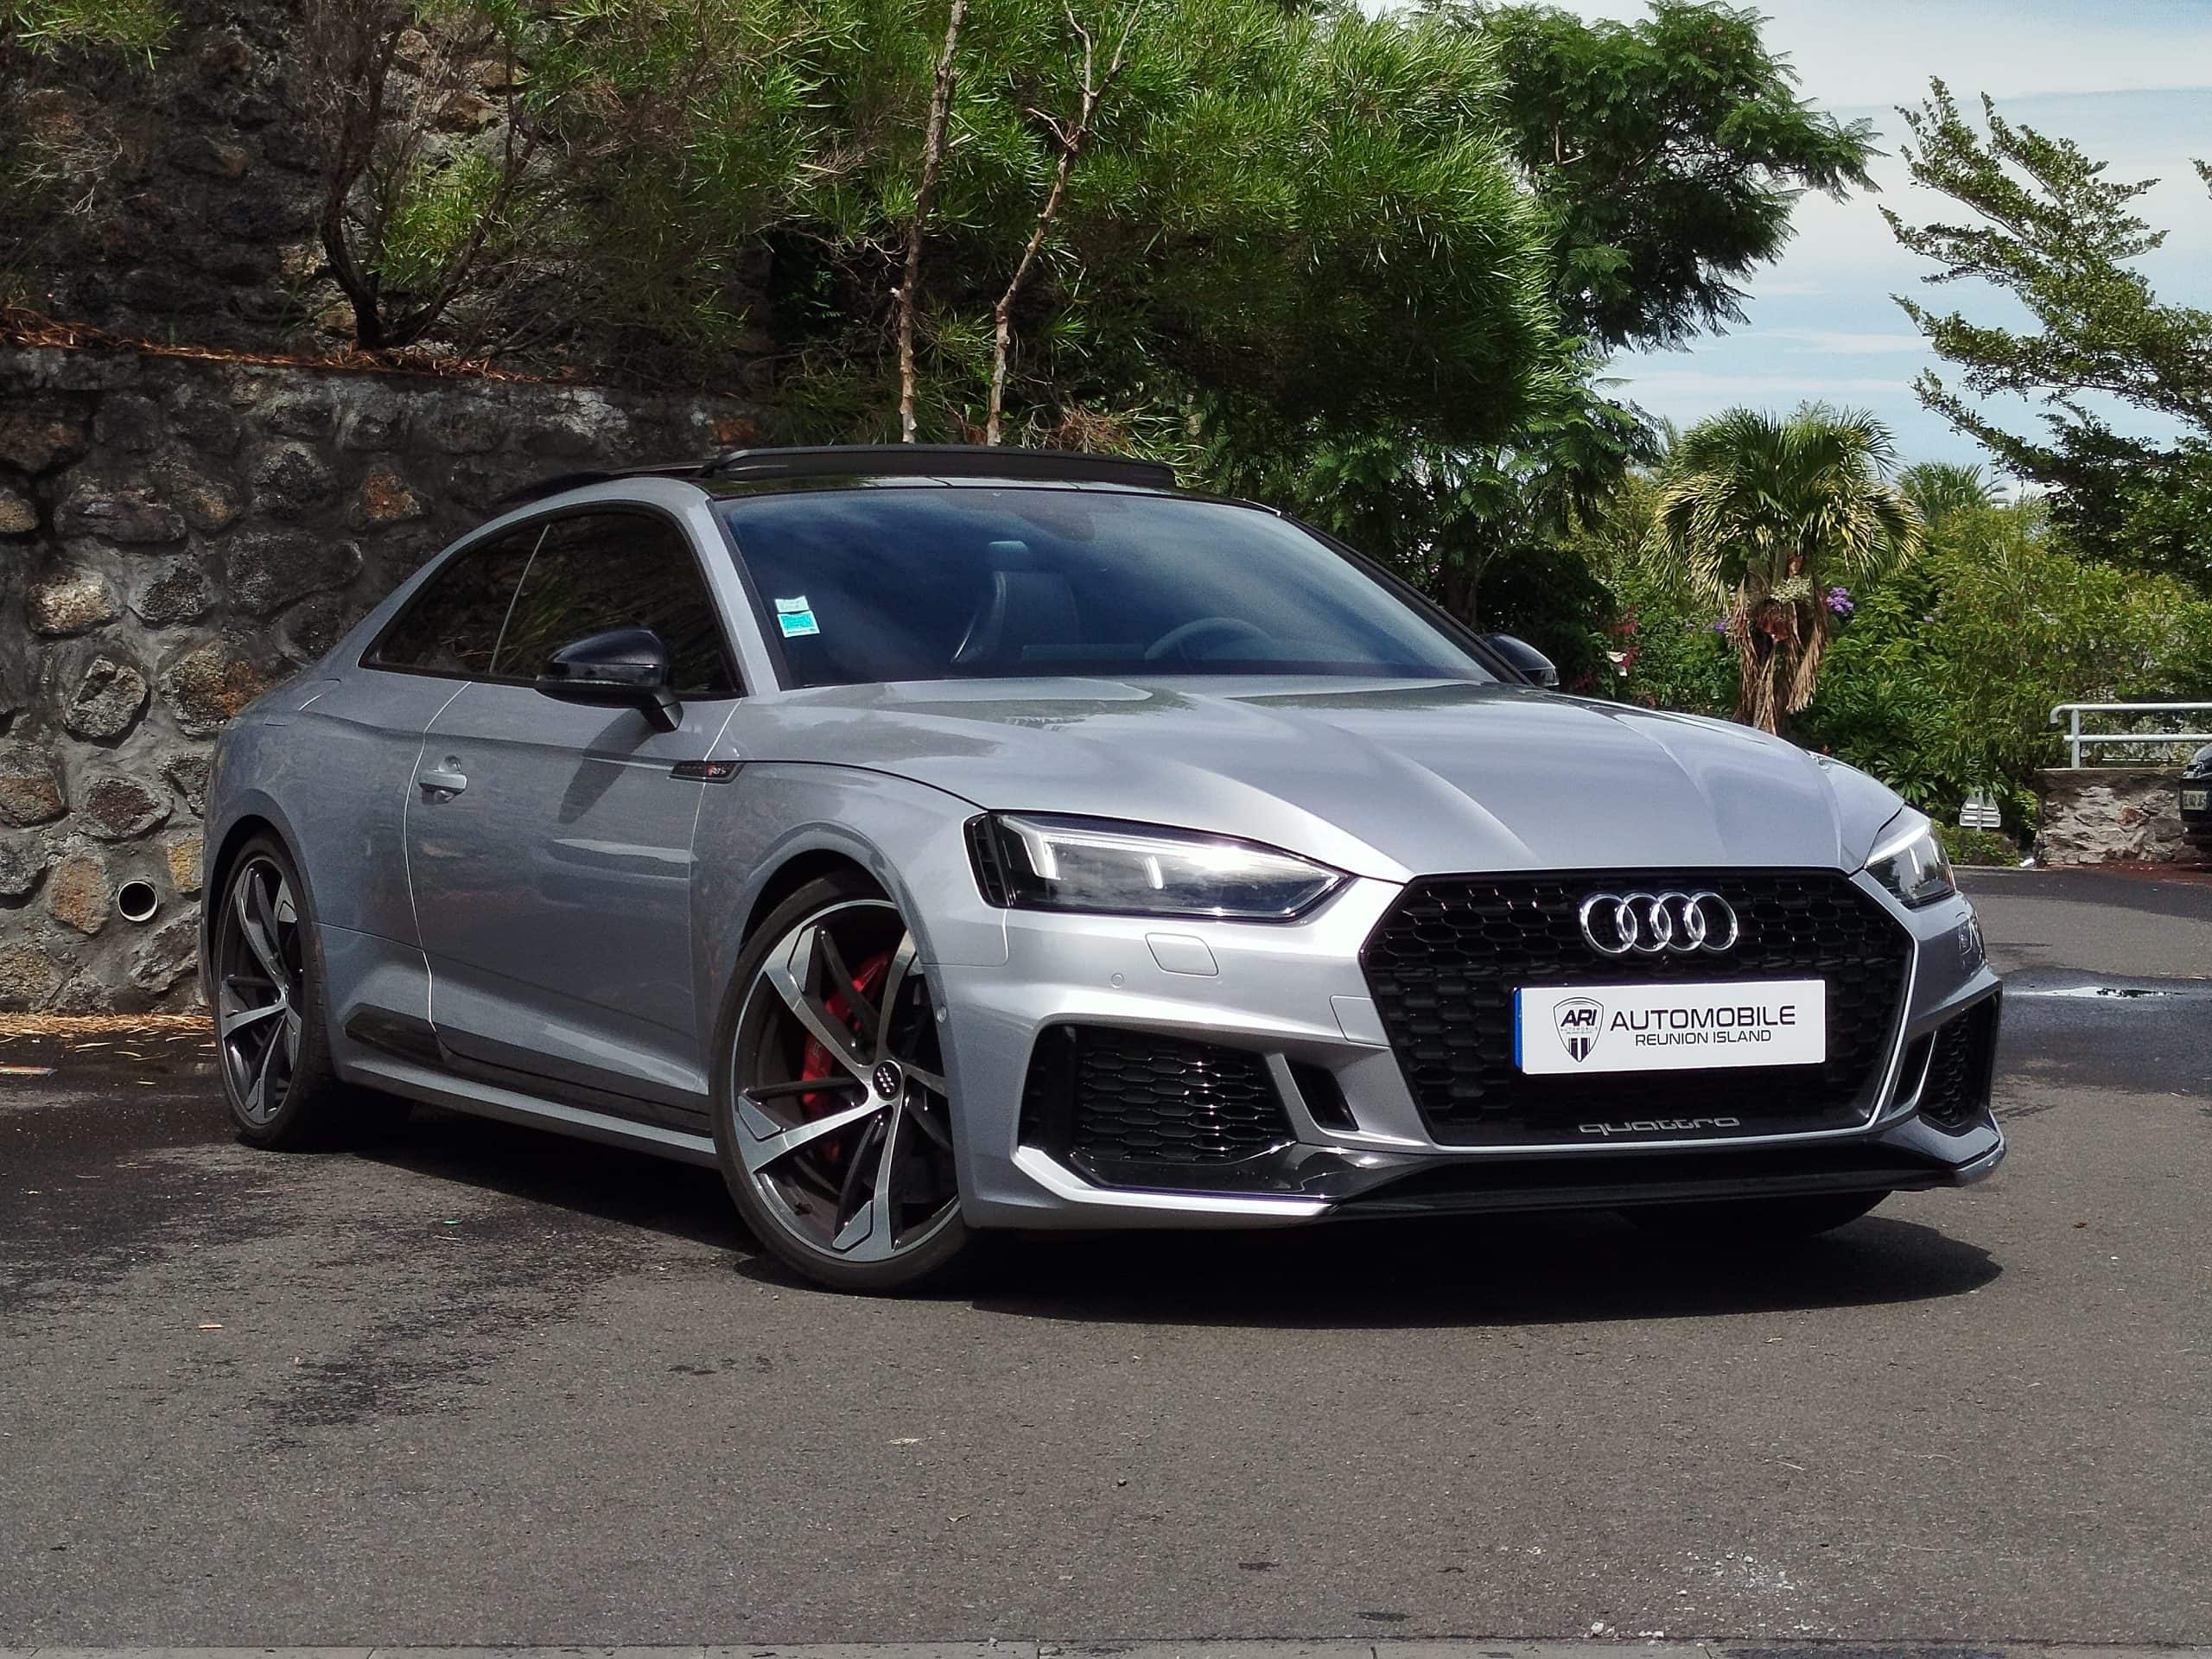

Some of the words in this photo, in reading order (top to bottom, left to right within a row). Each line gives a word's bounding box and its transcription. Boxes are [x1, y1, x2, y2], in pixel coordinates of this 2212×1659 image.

[1560, 1008, 1598, 1027] ARI
[1610, 1005, 1796, 1032] AUTOMOBILE
[1636, 1032, 1707, 1046] REUNION
[1713, 1029, 1771, 1044] ISLAND
[1579, 1117, 1740, 1136] quattro
